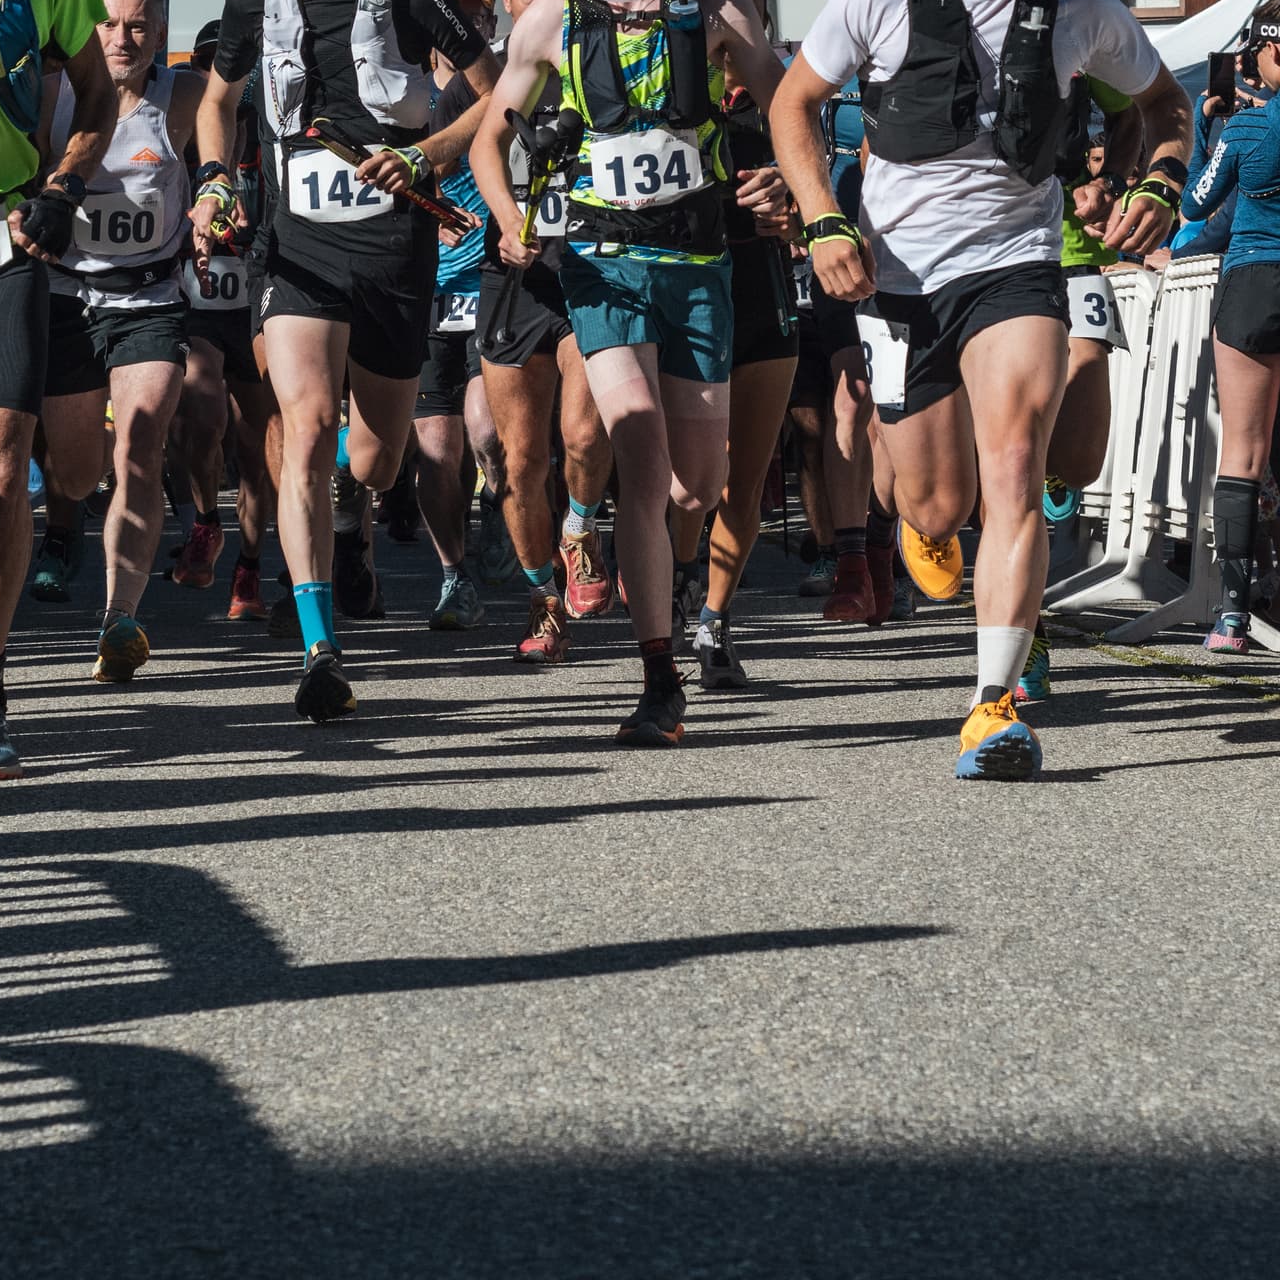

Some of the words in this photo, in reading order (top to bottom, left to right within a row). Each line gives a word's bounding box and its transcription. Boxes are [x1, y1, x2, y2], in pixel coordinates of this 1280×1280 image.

[302, 169, 381, 210] 142
[605, 150, 691, 197] 134
[87, 209, 155, 244] 160
